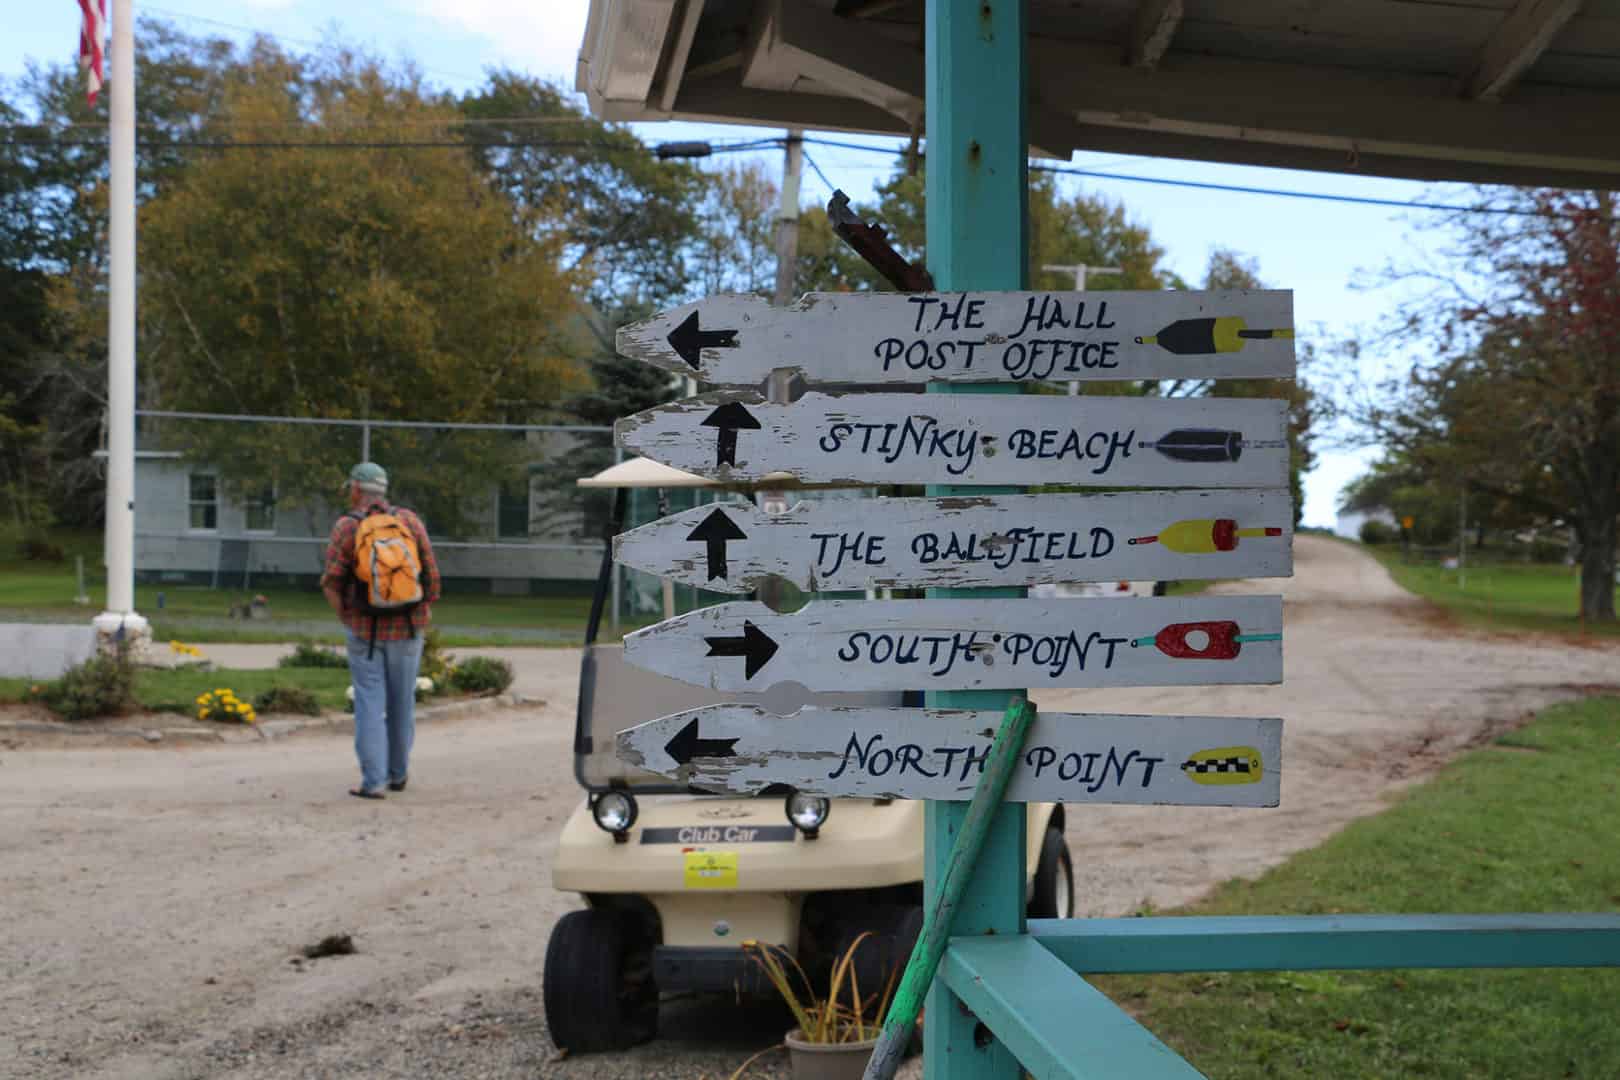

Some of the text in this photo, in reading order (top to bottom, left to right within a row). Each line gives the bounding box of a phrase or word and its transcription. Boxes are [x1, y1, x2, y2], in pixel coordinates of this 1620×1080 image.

[908, 293, 1115, 338] THE HALL
[874, 338, 1120, 378] POST OFFICE
[819, 415, 1136, 475] STINKY BEACH
[811, 531, 886, 577] THE
[838, 631, 1129, 679] SOUTH POINT
[828, 731, 1164, 792] NORTH POINT
[678, 826, 758, 843] Club Car
